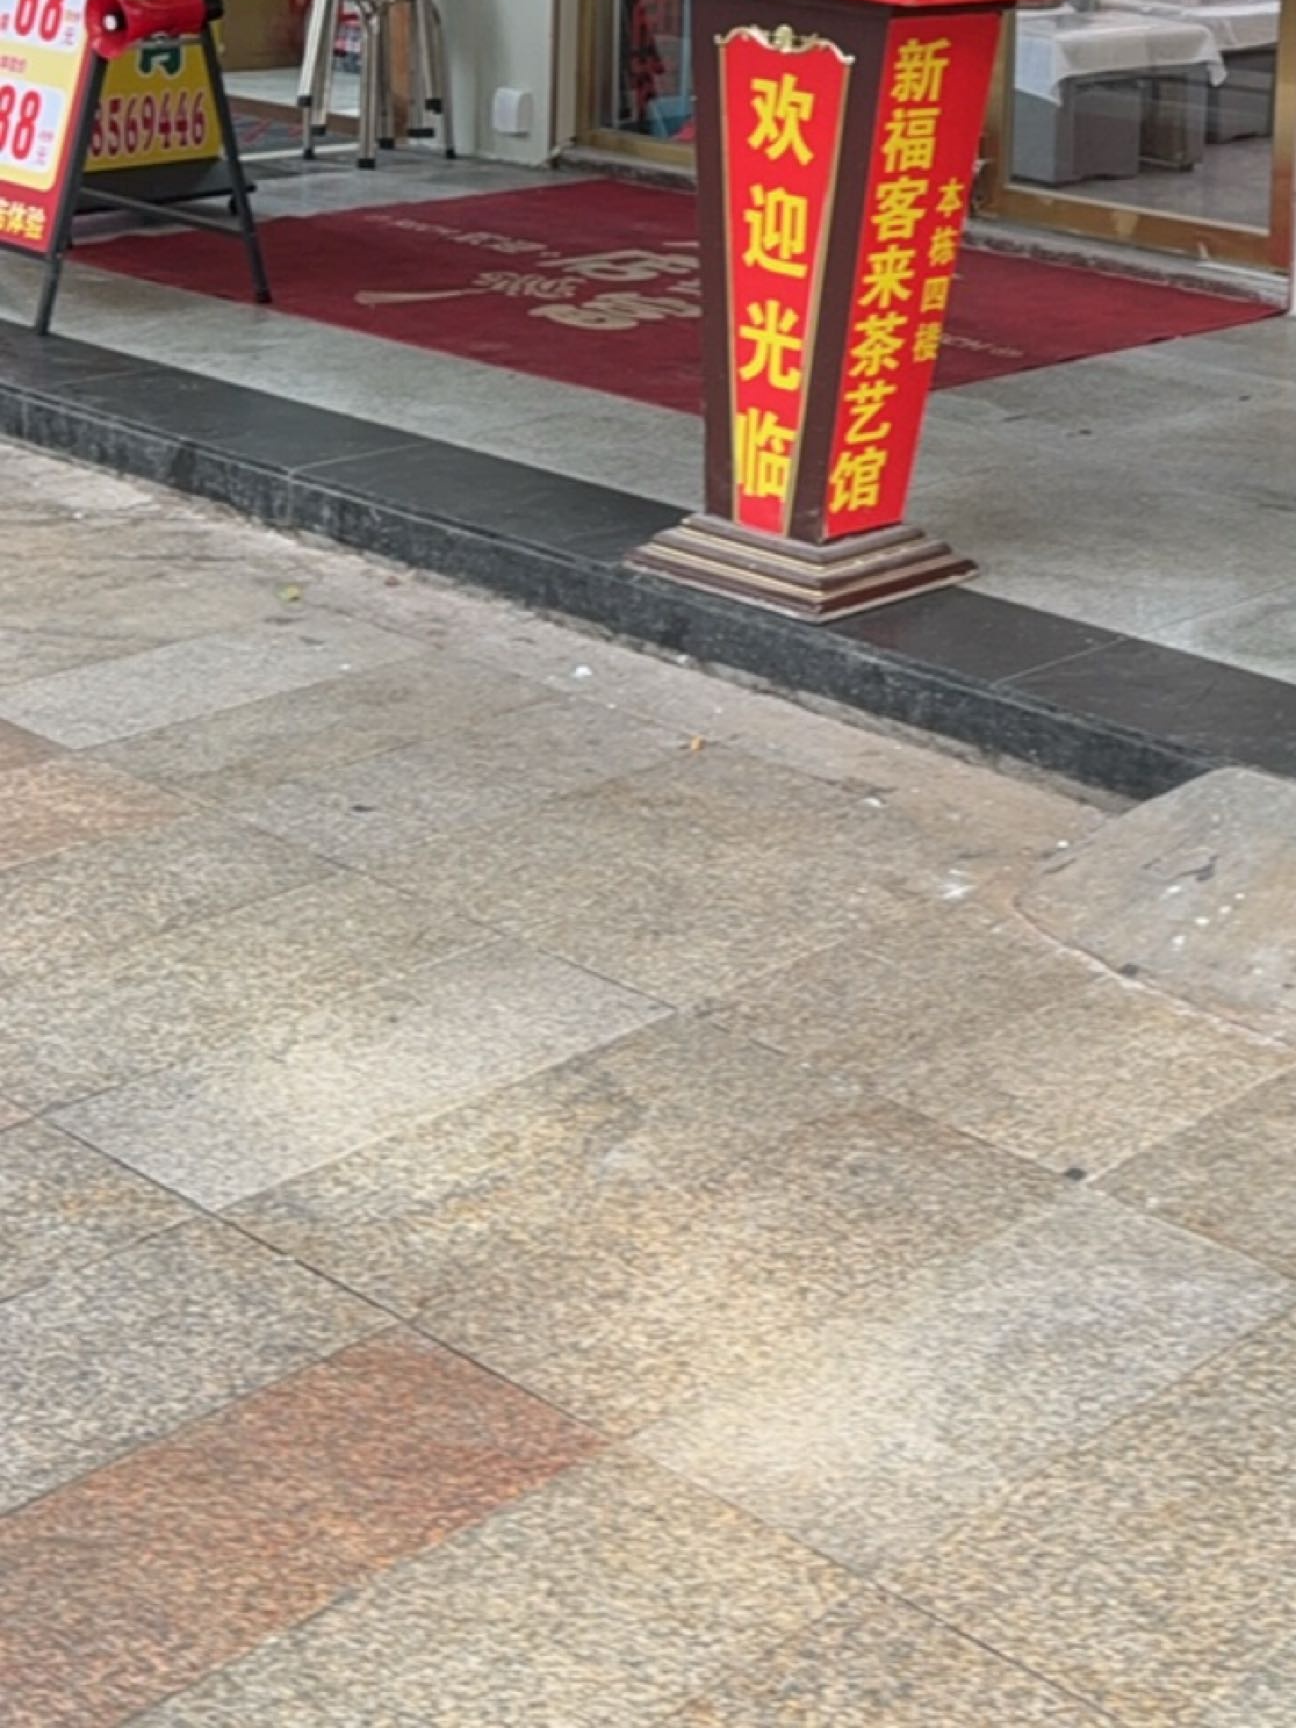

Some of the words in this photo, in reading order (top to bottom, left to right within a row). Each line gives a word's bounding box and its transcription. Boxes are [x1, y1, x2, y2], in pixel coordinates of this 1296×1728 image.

[736, 72, 815, 502] 欢迎光临
[830, 38, 951, 514] 新福客来茶艺馆
[913, 178, 963, 363] 本栋四楼
